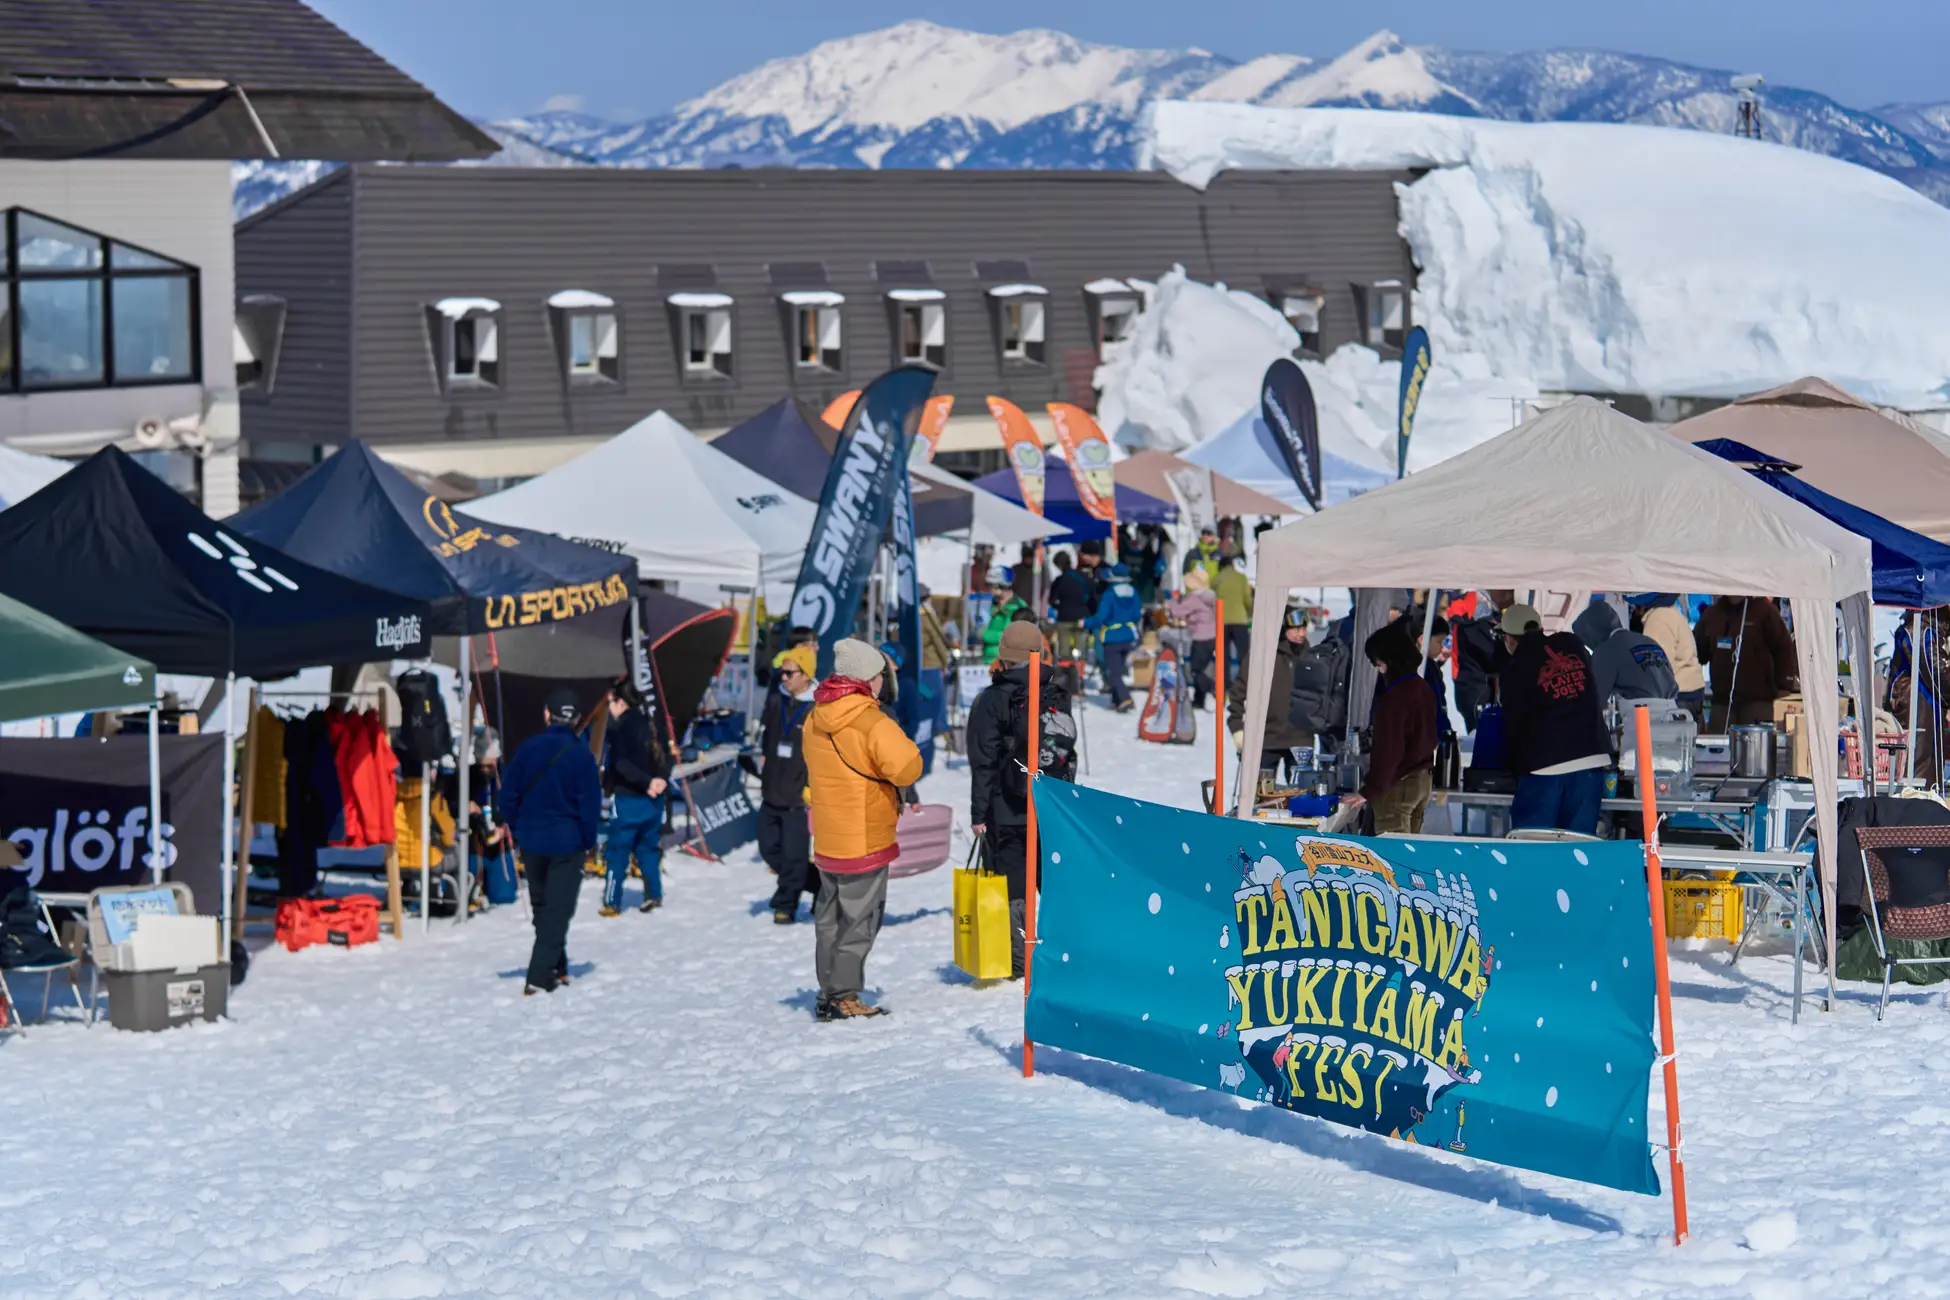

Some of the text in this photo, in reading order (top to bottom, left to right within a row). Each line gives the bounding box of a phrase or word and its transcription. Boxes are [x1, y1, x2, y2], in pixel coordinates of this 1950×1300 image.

[813, 409, 885, 587] SWANY
[376, 614, 421, 651] Haglöfs
[1542, 670, 1586, 693] PLAYER
[1553, 680, 1585, 700] JOE'S
[726, 792, 751, 820] ICE
[1233, 879, 1483, 1001] TANIGAWA
[1225, 957, 1468, 1070] YUKIYAMA
[1287, 1033, 1408, 1121] FEST
